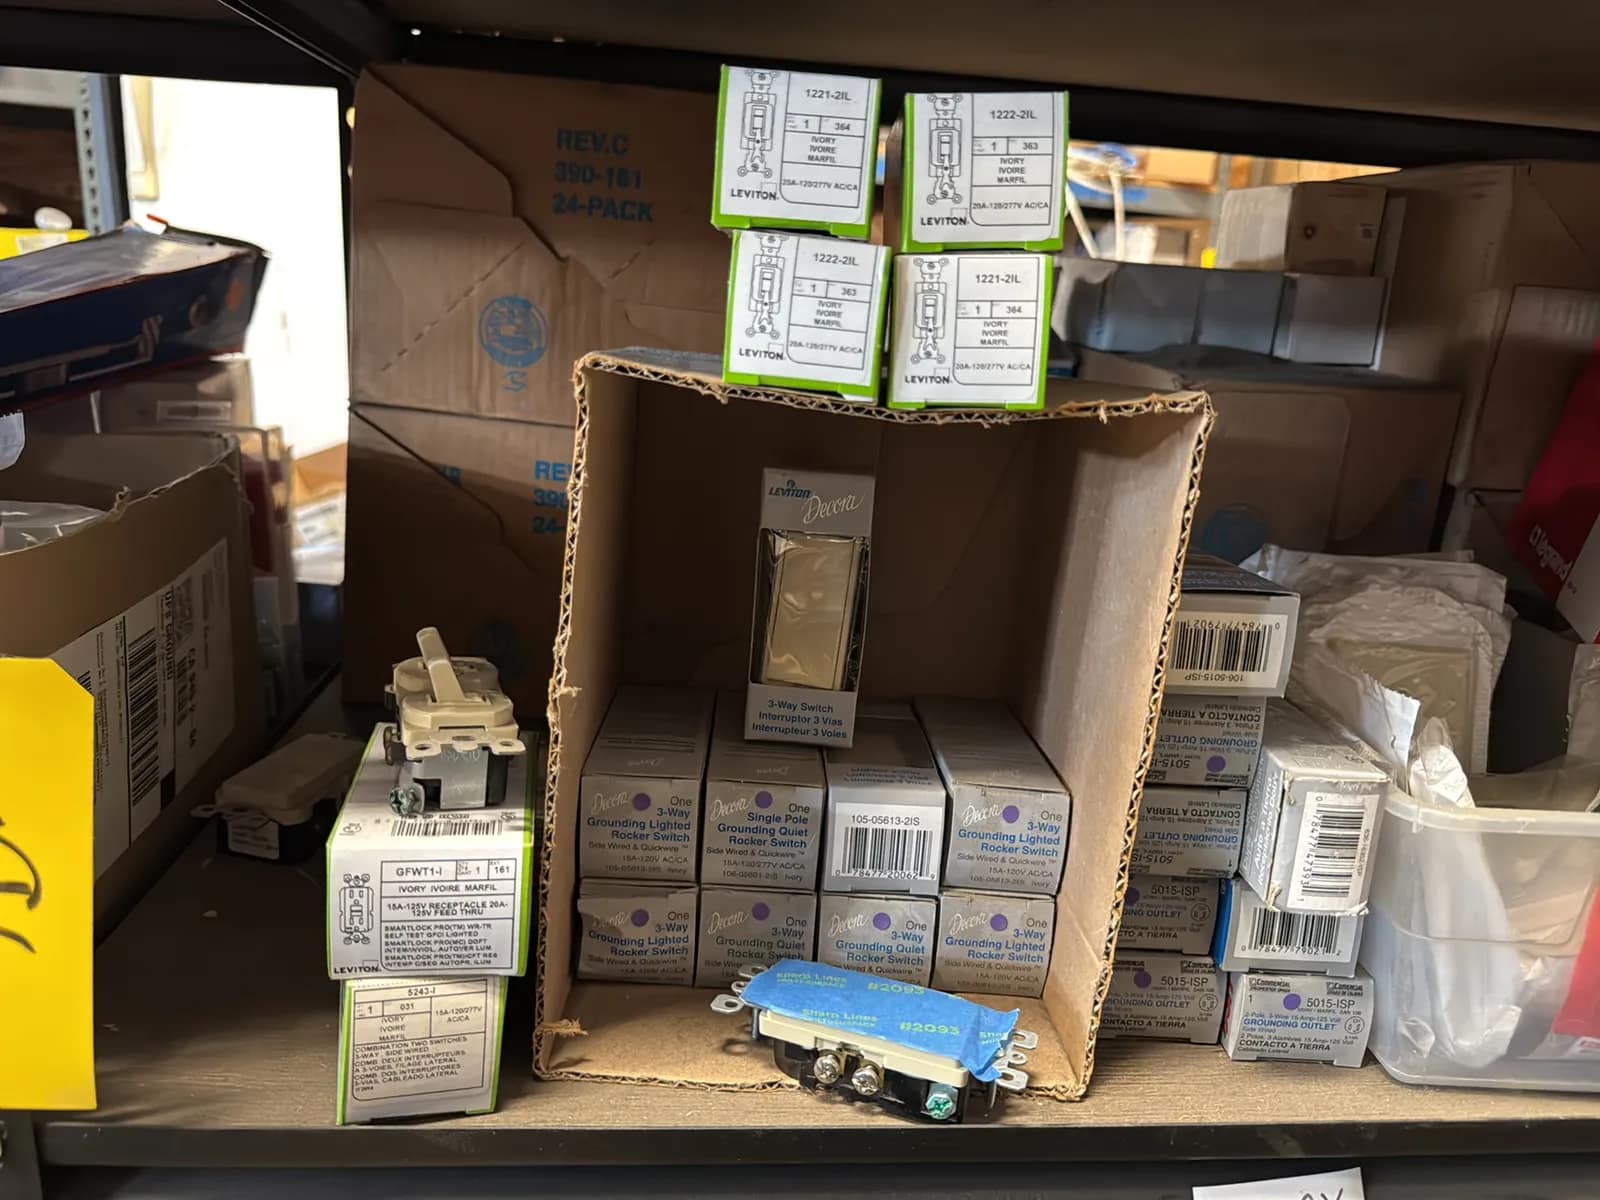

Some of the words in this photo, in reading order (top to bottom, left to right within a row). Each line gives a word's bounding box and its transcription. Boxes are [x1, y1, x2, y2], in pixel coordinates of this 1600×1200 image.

[805, 88, 851, 101] 1221-2IL
[990, 110, 1037, 120] 1222-2IL
[834, 122, 851, 132] 364
[811, 136, 836, 144] IVORY
[810, 145, 836, 153] IVOIRE
[1022, 142, 1038, 150] 363
[808, 155, 837, 164] MARFIL
[998, 166, 1026, 174] IVOIRE
[997, 176, 1027, 184] MARFIL
[730, 189, 777, 201] LEVITON
[552, 194, 654, 222] 24-PACK
[920, 217, 967, 226] LEVITON
[813, 253, 859, 266] 1222-2IL
[975, 274, 1021, 284] 1221-2IL
[841, 287, 857, 297] 363
[818, 301, 842, 309] IVORY
[1006, 305, 1022, 314] 364
[816, 310, 843, 319] IVOIRE
[814, 319, 843, 329] MARFIL
[983, 320, 1008, 328] IVORY
[982, 329, 1008, 337] IVOIRE
[980, 338, 1009, 346] MARFIL
[739, 348, 783, 360] LEVITON
[905, 375, 950, 384] LEVITON
[802, 494, 864, 524] Decora
[768, 700, 798, 712] 3-Way
[801, 703, 833, 713] Switch
[1161, 708, 1197, 718] TIERRA
[1208, 712, 1260, 722] CONTACTO
[759, 712, 811, 724] Interruptor
[813, 716, 820, 724] 3
[822, 717, 843, 726] Vias
[752, 723, 811, 736] Interrupteur
[821, 729, 847, 738] Voies
[1161, 735, 1196, 744] OUTLET
[1200, 737, 1257, 747] GROUNDING
[670, 796, 692, 806] One
[657, 807, 690, 819] 3-Way
[789, 803, 810, 813] One
[1147, 807, 1179, 815] TIERRA
[748, 812, 781, 824] Single
[785, 814, 808, 824] Pole
[1041, 811, 1062, 821] One
[1191, 809, 1240, 818] CONTACTO
[587, 817, 646, 830] Grounding
[650, 820, 690, 831] Lighted
[852, 815, 920, 825] 105-05613-2IS
[718, 823, 775, 836] Grounding
[779, 827, 808, 837] Quiet
[1027, 822, 1060, 834] 3-Way
[612, 830, 650, 840] Rocker
[653, 832, 690, 842] Switch
[959, 829, 1015, 843] Grounding
[1020, 834, 1060, 845] Lighted
[1144, 832, 1179, 840] OUTLET
[1183, 833, 1238, 843] GROUNDING
[729, 836, 767, 845] Rocker
[770, 838, 807, 848] Switch
[981, 843, 1019, 854] Rocker
[1022, 846, 1058, 857] Switch
[396, 867, 442, 876] GFWT1-I
[399, 885, 425, 893] IVORY
[1151, 885, 1200, 896] 5015-ISP
[668, 912, 689, 920] One
[1147, 910, 1183, 918] OUTLET
[786, 917, 807, 927] One
[906, 920, 927, 931] One
[1026, 917, 1047, 928] One
[655, 923, 688, 932] 3-Way
[589, 930, 644, 947] Grounding
[648, 936, 688, 946] Lighted
[772, 928, 804, 939] 3-Way
[891, 931, 924, 943] 3-Way
[1013, 929, 1045, 941] 3-Way
[716, 936, 773, 949] Grounding
[777, 940, 805, 950] Quiet
[836, 940, 893, 954] Grounding
[896, 944, 925, 954] Quiet
[945, 937, 1002, 950] Grounding
[1005, 941, 1045, 951] Lighted
[610, 947, 648, 956] Rocker
[652, 947, 688, 955] Switch
[728, 949, 765, 958] Rocker
[968, 950, 1005, 960] Rocker
[1008, 953, 1043, 962] Switch
[847, 952, 885, 962] Rocker
[888, 955, 923, 966] Switch
[334, 964, 379, 973] LEVITON
[1161, 976, 1208, 986] 5015-ISP
[408, 987, 435, 996] 5243-I
[1156, 1000, 1190, 1008] OUTLET
[1307, 998, 1355, 1008] 5015-ISP
[368, 1006, 372, 1014] 1
[844, 1013, 878, 1023] Lines
[1244, 1018, 1298, 1028] GROUNDING
[1301, 1022, 1336, 1030] OUTLET
[379, 1033, 406, 1041] MARFIL
[355, 1041, 409, 1053] COMBINATION
[411, 1039, 427, 1047] TWO
[429, 1036, 467, 1045] SWITCHES
[1240, 1040, 1287, 1048] CONTACTO
[405, 1046, 429, 1054] WIRED
[424, 1058, 457, 1066] LATERAL
[426, 1070, 459, 1078] LATERAL
